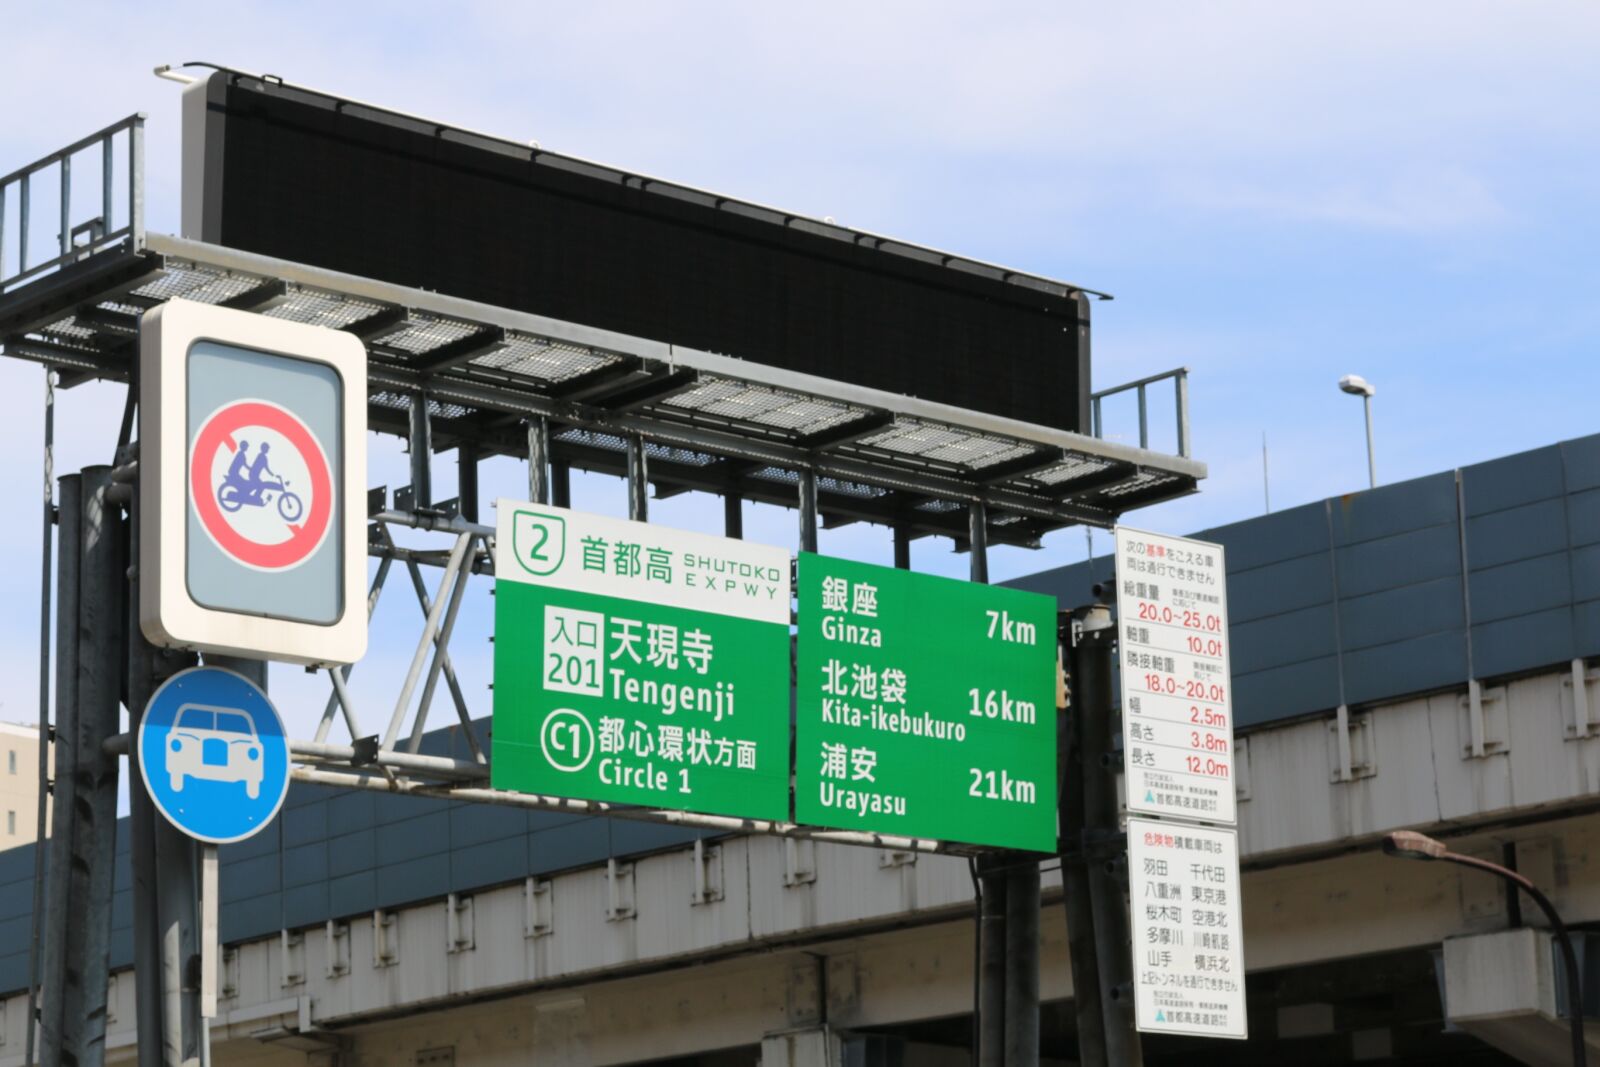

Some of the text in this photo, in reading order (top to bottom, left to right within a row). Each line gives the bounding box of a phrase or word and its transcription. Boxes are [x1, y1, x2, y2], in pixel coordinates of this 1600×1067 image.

[529, 523, 549, 562] 2
[580, 535, 674, 584] 首都高
[683, 553, 780, 582] SHUTOKO
[821, 575, 878, 617] 銀座
[551, 616, 597, 649] 入口
[821, 615, 882, 648] Ginza
[985, 610, 1036, 645] 7km
[609, 616, 714, 675] 天現寺
[1187, 635, 1223, 657] 10.0t
[548, 652, 600, 689] 201
[821, 658, 907, 704] 北池袋
[609, 668, 735, 722] Tengenji
[968, 688, 1036, 725] 16km
[821, 698, 966, 742] Kita-ikebukuro
[1130, 721, 1155, 742] 高さ
[1190, 706, 1226, 727] 2.5m
[549, 721, 580, 759] C1
[598, 715, 757, 770] 都心環状方面
[1191, 731, 1227, 753] 3.8m
[820, 741, 877, 783] 浦安
[1131, 747, 1156, 767] 長さ
[1186, 755, 1229, 778] 12.0m
[599, 758, 692, 794] Circle 1
[968, 768, 1036, 804] 21km
[819, 781, 906, 817] Urayasu
[1143, 857, 1168, 877] 羽田
[1190, 863, 1226, 883] 千代田
[1145, 881, 1182, 901] 八重洲
[1191, 885, 1227, 906] 東京港
[1145, 903, 1182, 924] 桜木町
[1192, 909, 1228, 928] 空港北
[1147, 926, 1184, 946] 多摩川
[1147, 949, 1173, 968] 山手
[1194, 954, 1231, 973] 横浜北
